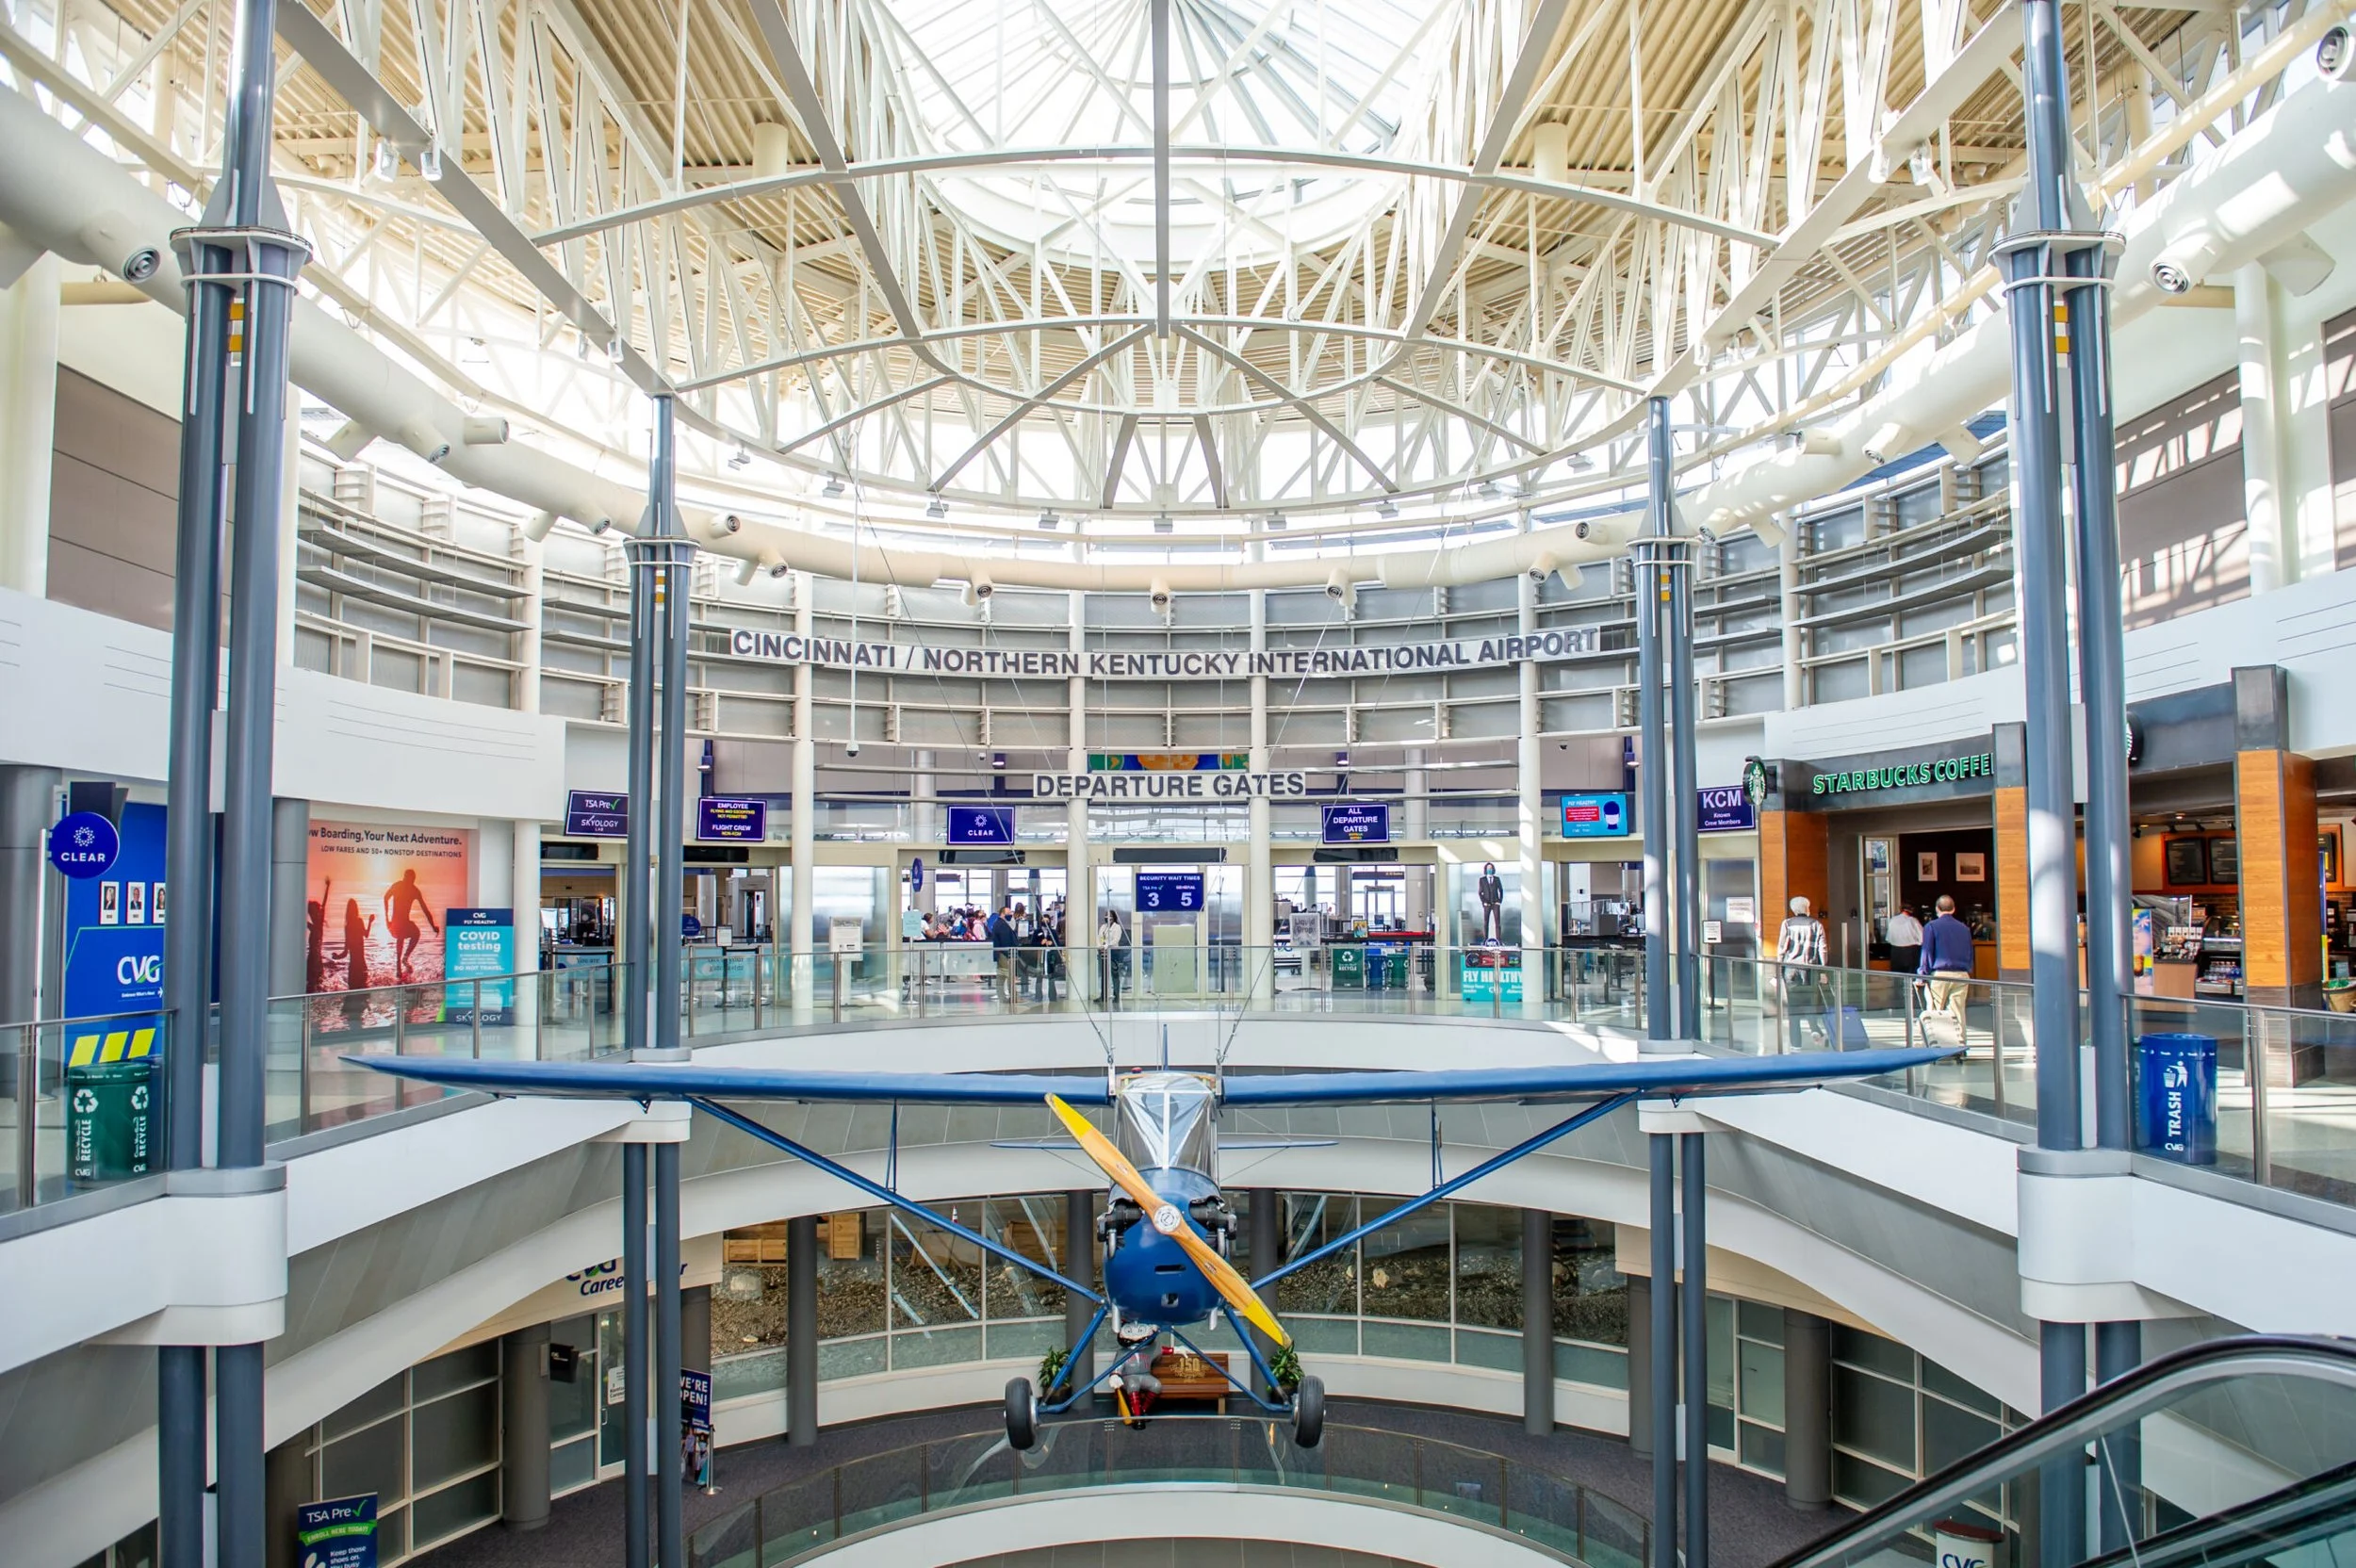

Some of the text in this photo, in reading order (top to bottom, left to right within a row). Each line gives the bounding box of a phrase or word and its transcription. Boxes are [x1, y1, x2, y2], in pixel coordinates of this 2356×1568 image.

[734, 630, 895, 667] CINCINNATI
[924, 648, 1079, 674] NORTHERN
[1090, 653, 1236, 676] KENTUCKY
[1249, 643, 1469, 674] INTERNATIONAL
[1478, 628, 1598, 662] AIRPORT
[1813, 761, 1931, 794] STARBUCKS
[1037, 774, 1305, 797] DEPARTURE GATES
[584, 799, 611, 808] TSA Pre
[1703, 790, 1742, 808] KCM
[581, 818, 618, 827] SKYOLOGY
[364, 830, 384, 841] Your
[386, 831, 409, 842] Next
[411, 833, 462, 845] Adventure.
[61, 852, 106, 862] CLEAR
[1148, 892, 1159, 906] 3
[1181, 892, 1192, 906] 5
[459, 931, 499, 940] COVID
[458, 942, 500, 952] testing
[118, 956, 159, 984] CVG
[1463, 971, 1522, 983] FLY HELTHY
[2168, 1091, 2182, 1137] TRASH
[81, 1119, 91, 1161] RECYCLE
[2165, 1142, 2184, 1152] CVG
[580, 1275, 625, 1296] Caree
[1180, 1358, 1201, 1372] 150
[679, 1390, 708, 1406] PEN!
[306, 1508, 352, 1523] TSA Pre
[330, 1549, 347, 1558] Keep
[330, 1556, 349, 1564] shoes
